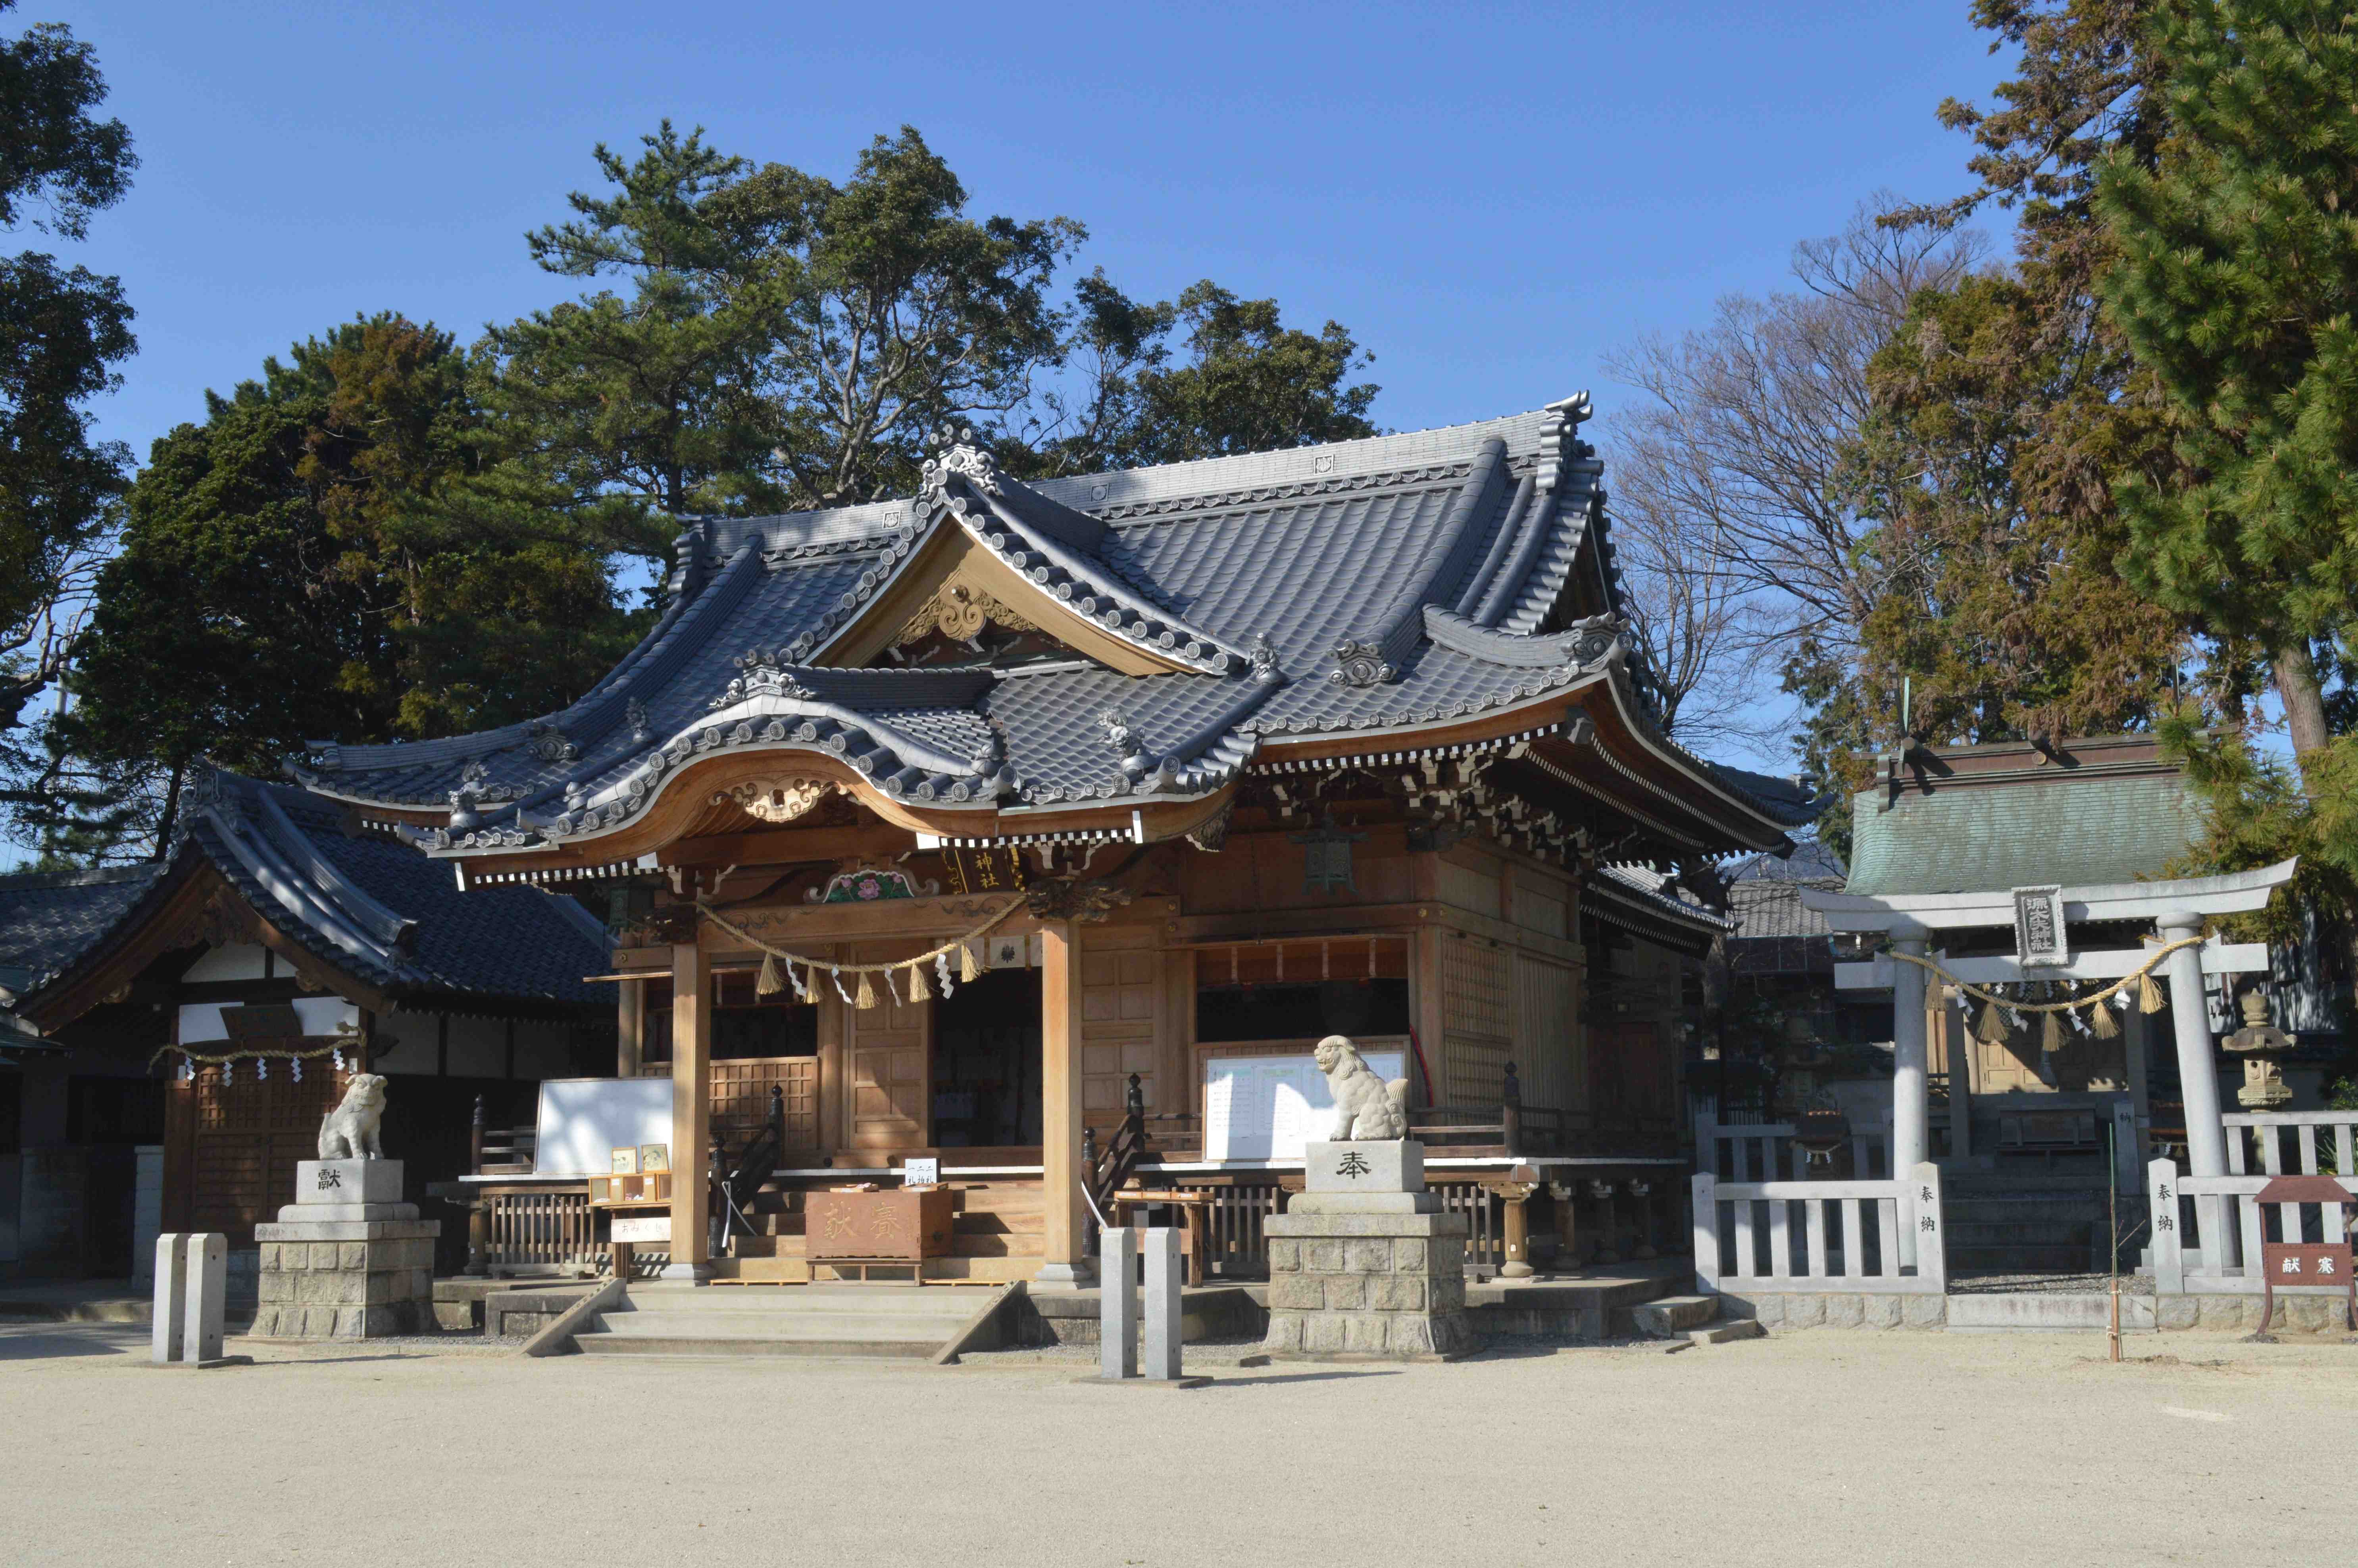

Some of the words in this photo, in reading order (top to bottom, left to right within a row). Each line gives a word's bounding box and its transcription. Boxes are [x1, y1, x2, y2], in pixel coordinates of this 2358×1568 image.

[975, 852, 1000, 889] 神社
[1336, 1151, 1371, 1179] 奉
[1921, 1186, 1935, 1232] 奉納
[2158, 1184, 2173, 1231] 奉納
